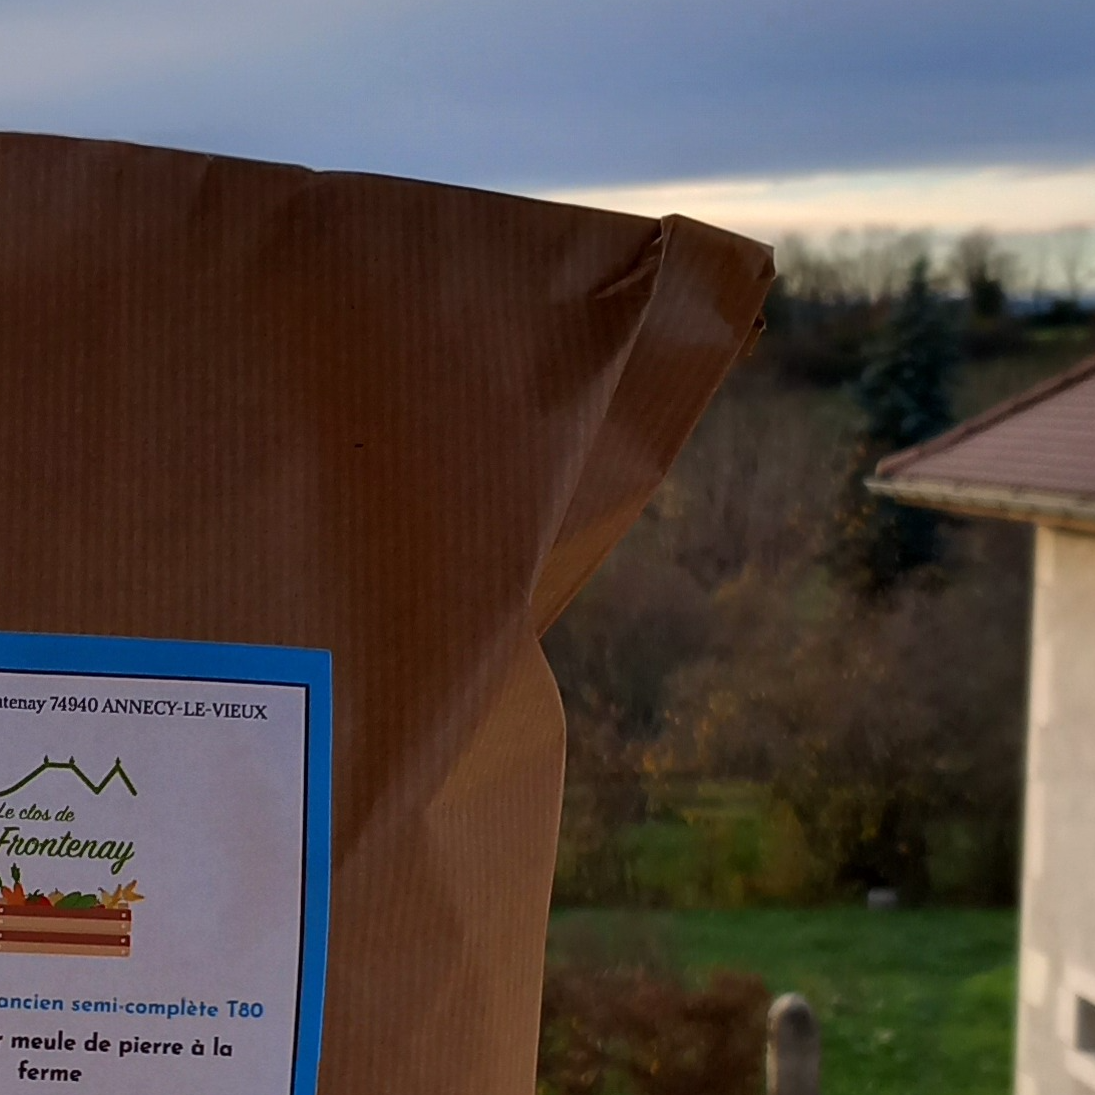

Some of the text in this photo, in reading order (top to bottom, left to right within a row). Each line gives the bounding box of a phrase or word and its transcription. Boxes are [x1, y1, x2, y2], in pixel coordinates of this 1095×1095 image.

[49, 696, 98, 713] 74940
[101, 698, 268, 720] ANNECY-LE-VIEUX
[19, 803, 51, 821] clos
[55, 805, 75, 821] de
[71, 997, 219, 1019] semi-complète
[227, 1000, 264, 1018] T80
[11, 1030, 76, 1050] meule
[84, 1032, 111, 1052] de
[119, 1036, 183, 1058] pierre
[191, 1039, 205, 1056] à
[213, 1036, 233, 1057] la
[18, 1060, 82, 1082] ferme
